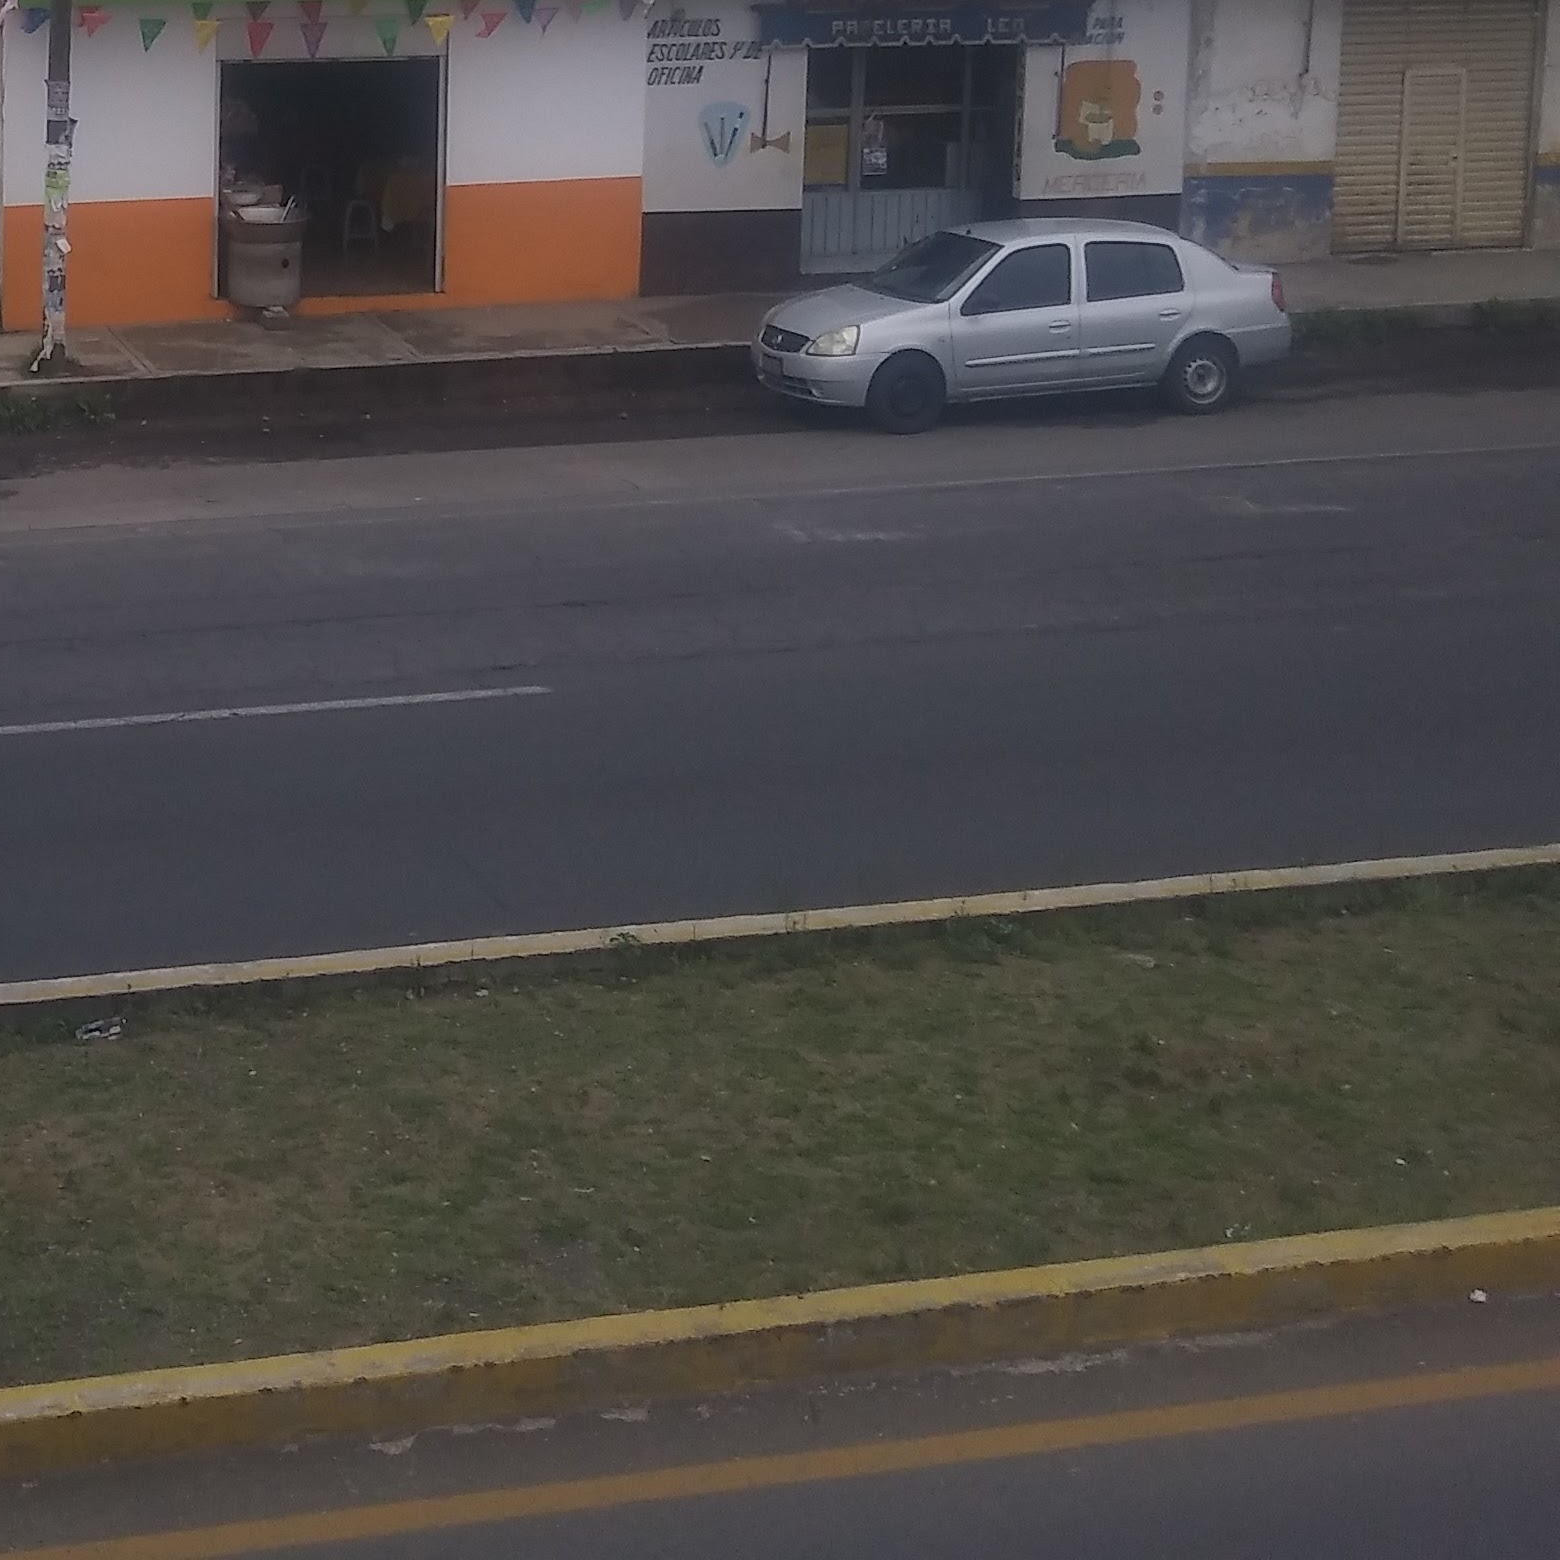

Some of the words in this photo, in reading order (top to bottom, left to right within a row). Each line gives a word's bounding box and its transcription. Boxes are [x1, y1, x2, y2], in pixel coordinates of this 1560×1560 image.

[831, 18, 952, 36] PAELERIA
[646, 41, 727, 62] ESCOLARES
[647, 64, 704, 86] OFICINA
